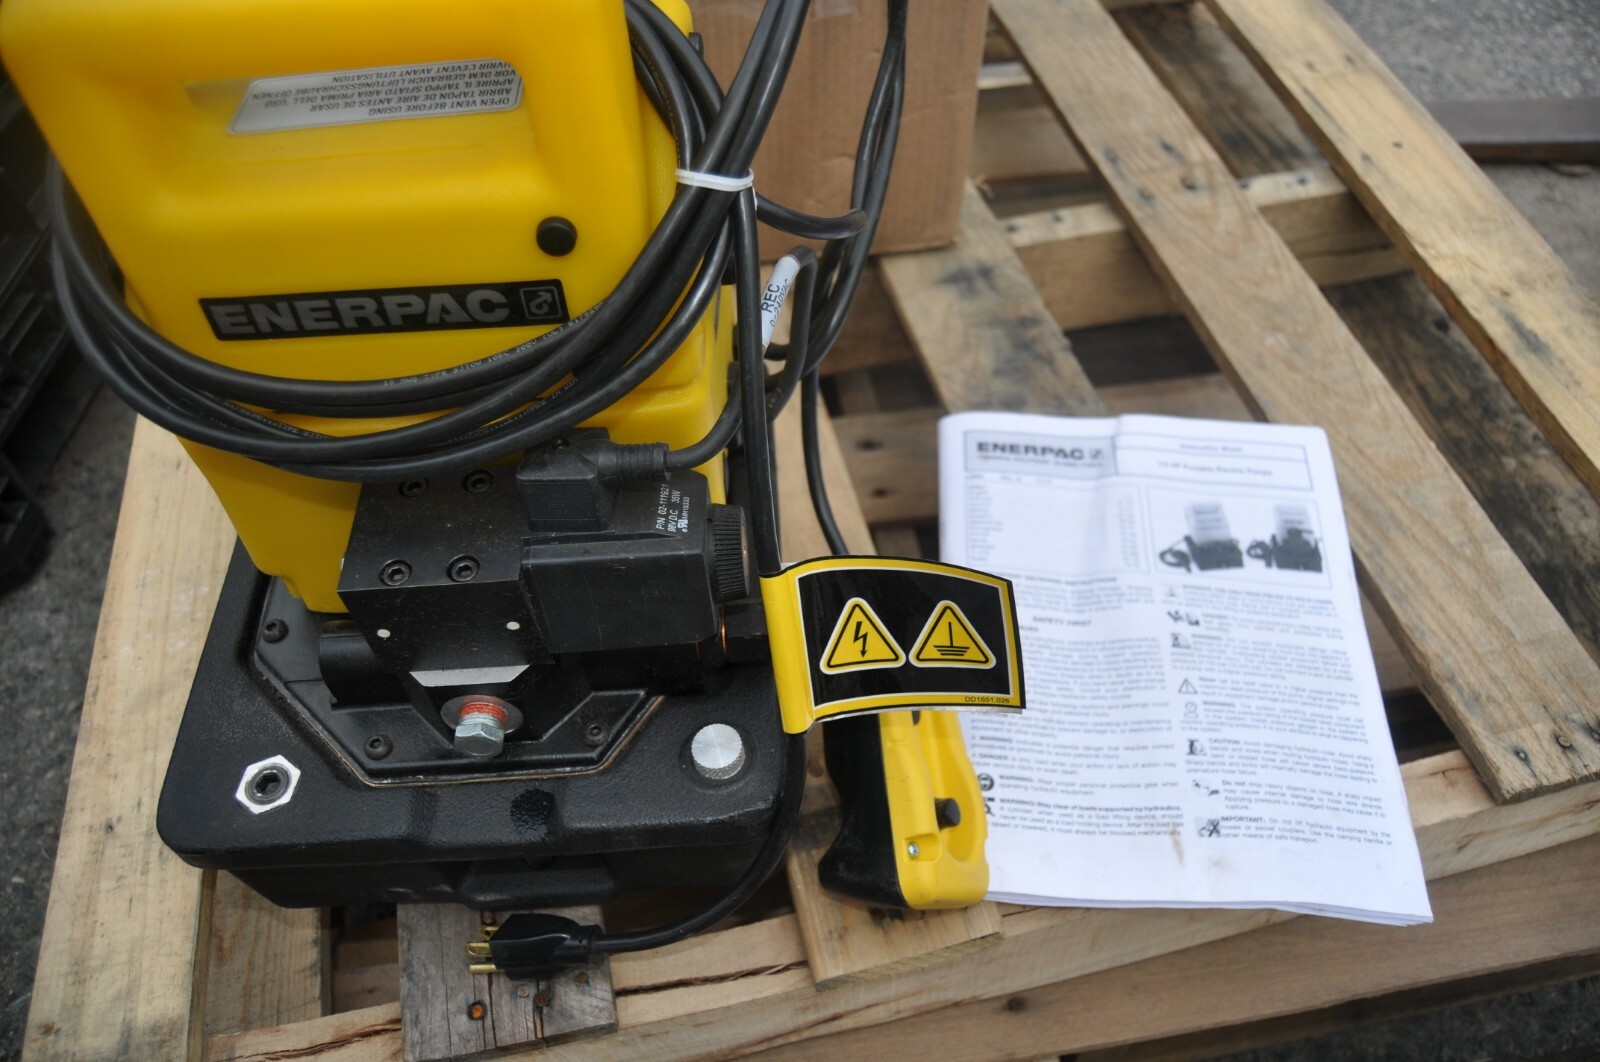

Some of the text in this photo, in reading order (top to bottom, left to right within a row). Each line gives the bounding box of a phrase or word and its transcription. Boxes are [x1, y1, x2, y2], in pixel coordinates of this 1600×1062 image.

[332, 71, 396, 83] UTILISATION
[400, 68, 433, 77] AVANT
[468, 71, 492, 80] DEM
[494, 69, 516, 78] VOR
[408, 72, 466, 84] GEBRAUCH
[474, 78, 514, 88] APRIRE
[384, 84, 422, 96] SFIATO
[424, 82, 460, 92] TAPPO
[478, 88, 512, 96] ABRIR
[320, 92, 354, 102] PRIMA
[358, 88, 381, 98] ARIA
[440, 90, 475, 100] TAPON
[358, 96, 394, 106] ANTES
[396, 94, 420, 104] AIRE
[310, 102, 340, 112] USAR
[341, 101, 356, 109] DE
[368, 97, 510, 116] OPEN VENT BEFORE USING
[761, 284, 780, 314] REC
[209, 289, 510, 334] ENERPAC
[977, 442, 1084, 460] ENERPAC
[656, 516, 666, 530] P/N
